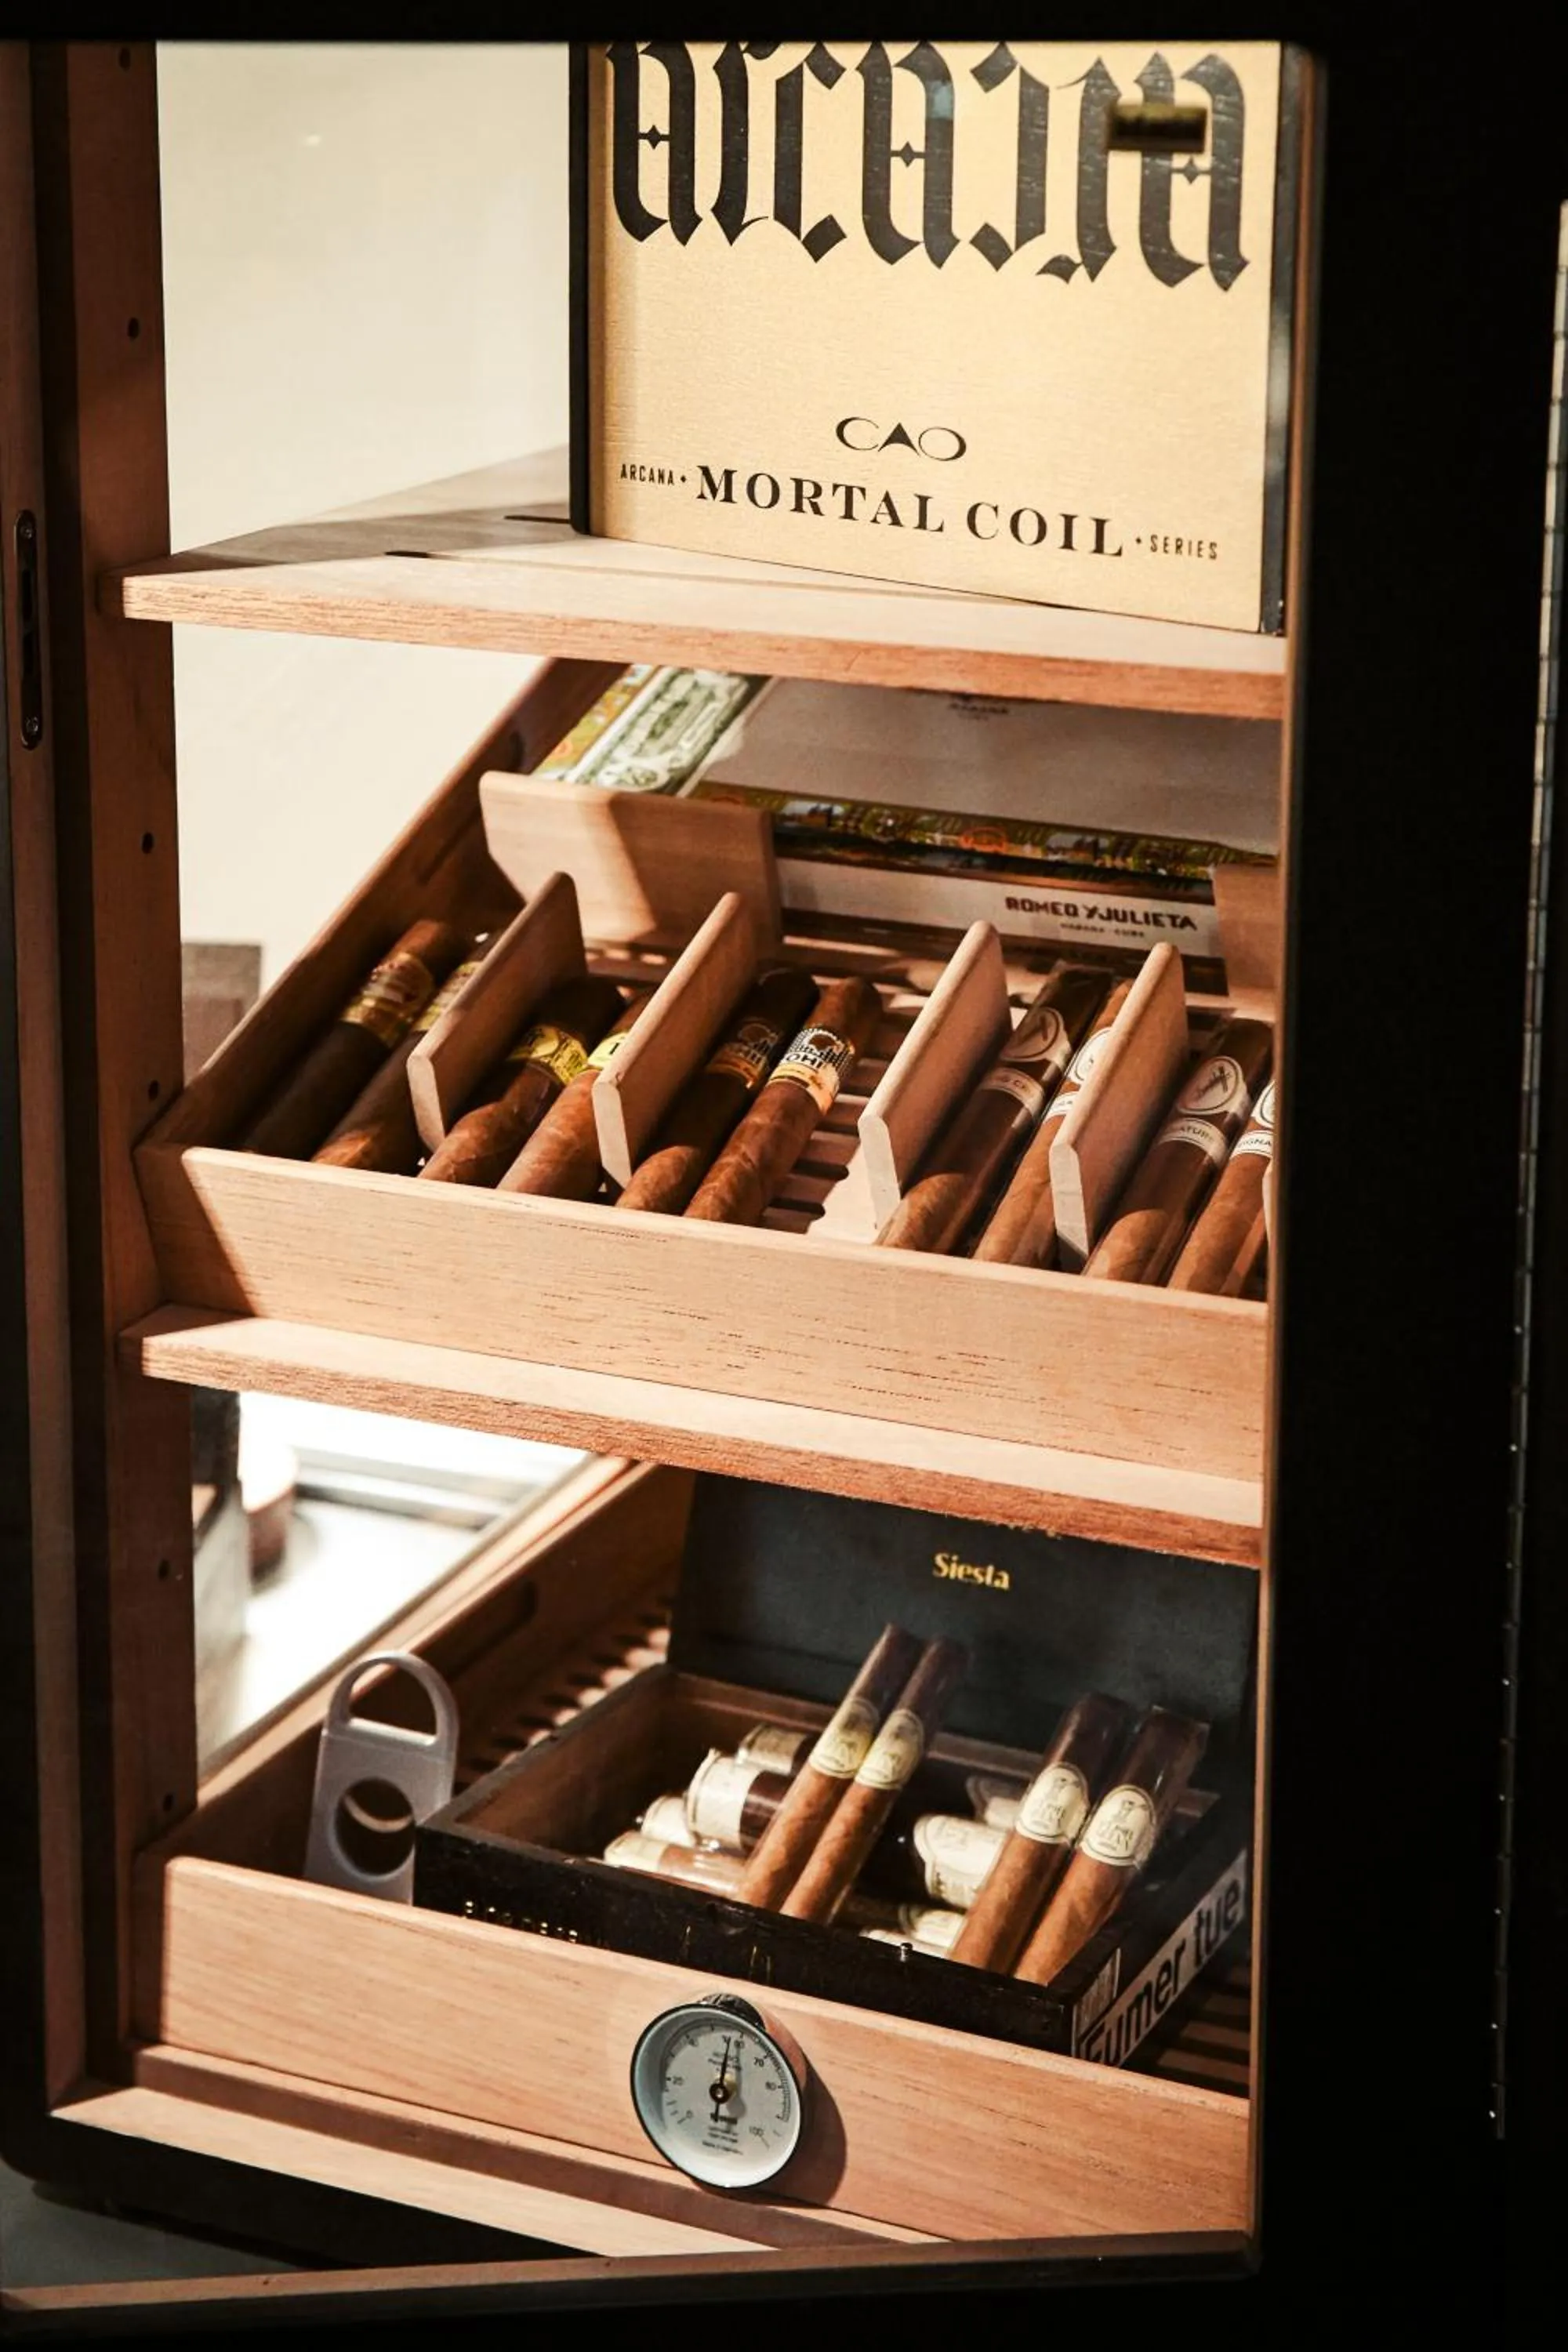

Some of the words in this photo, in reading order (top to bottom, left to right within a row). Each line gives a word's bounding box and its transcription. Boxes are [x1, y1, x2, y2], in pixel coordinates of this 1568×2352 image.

[836, 416, 967, 462] CAO
[620, 463, 674, 485] ARCANA
[696, 465, 944, 533] MORTAL
[966, 502, 1124, 557] COIL
[1149, 534, 1218, 561] SERIES
[1005, 896, 1079, 917] ROMEO
[1083, 904, 1099, 920] Y
[1098, 907, 1198, 931] JULIETA
[933, 1552, 1010, 1591] Siesta
[1192, 1878, 1240, 1967] tue
